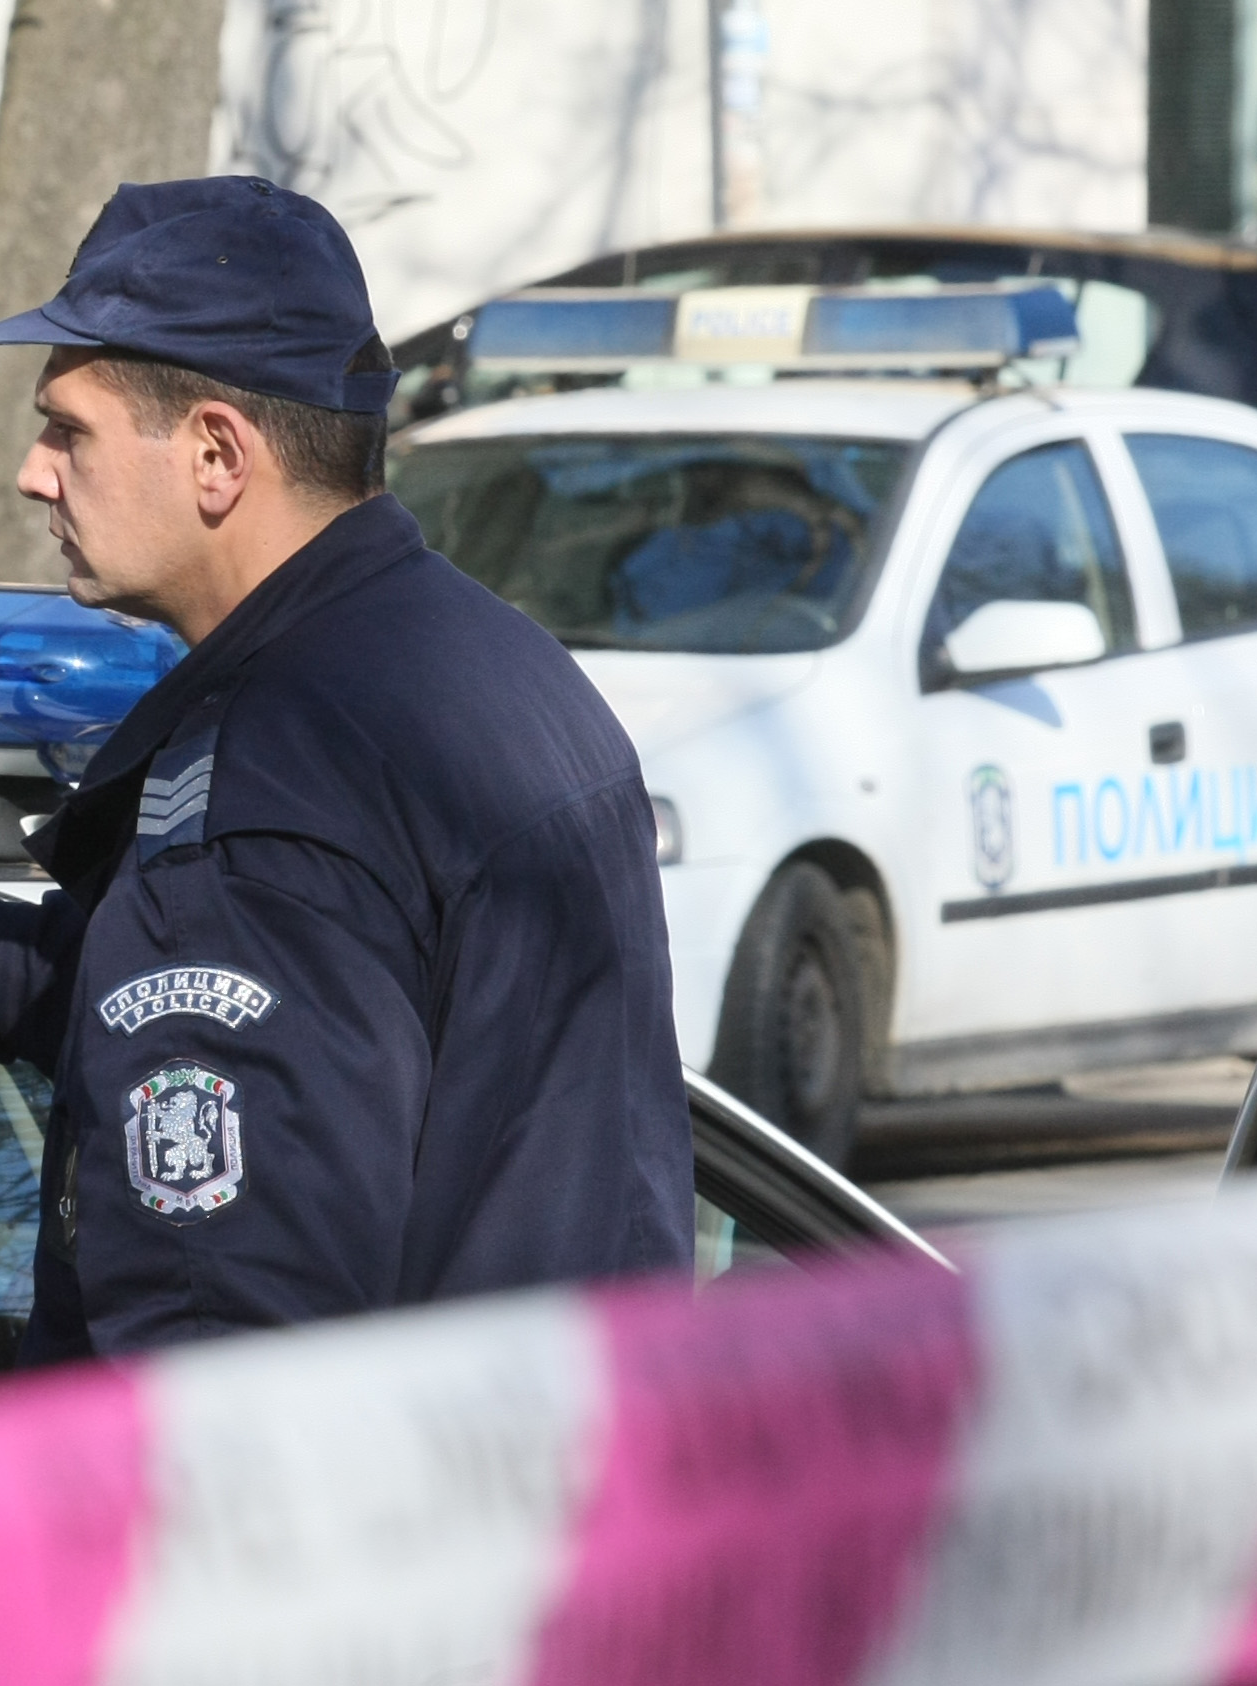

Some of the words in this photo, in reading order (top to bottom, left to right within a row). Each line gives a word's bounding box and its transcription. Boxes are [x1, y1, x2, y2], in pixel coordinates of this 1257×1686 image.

[691, 308, 789, 337] POLICE
[116, 972, 253, 1010] ПОЛИЦИЯ
[133, 994, 231, 1021] POLICE
